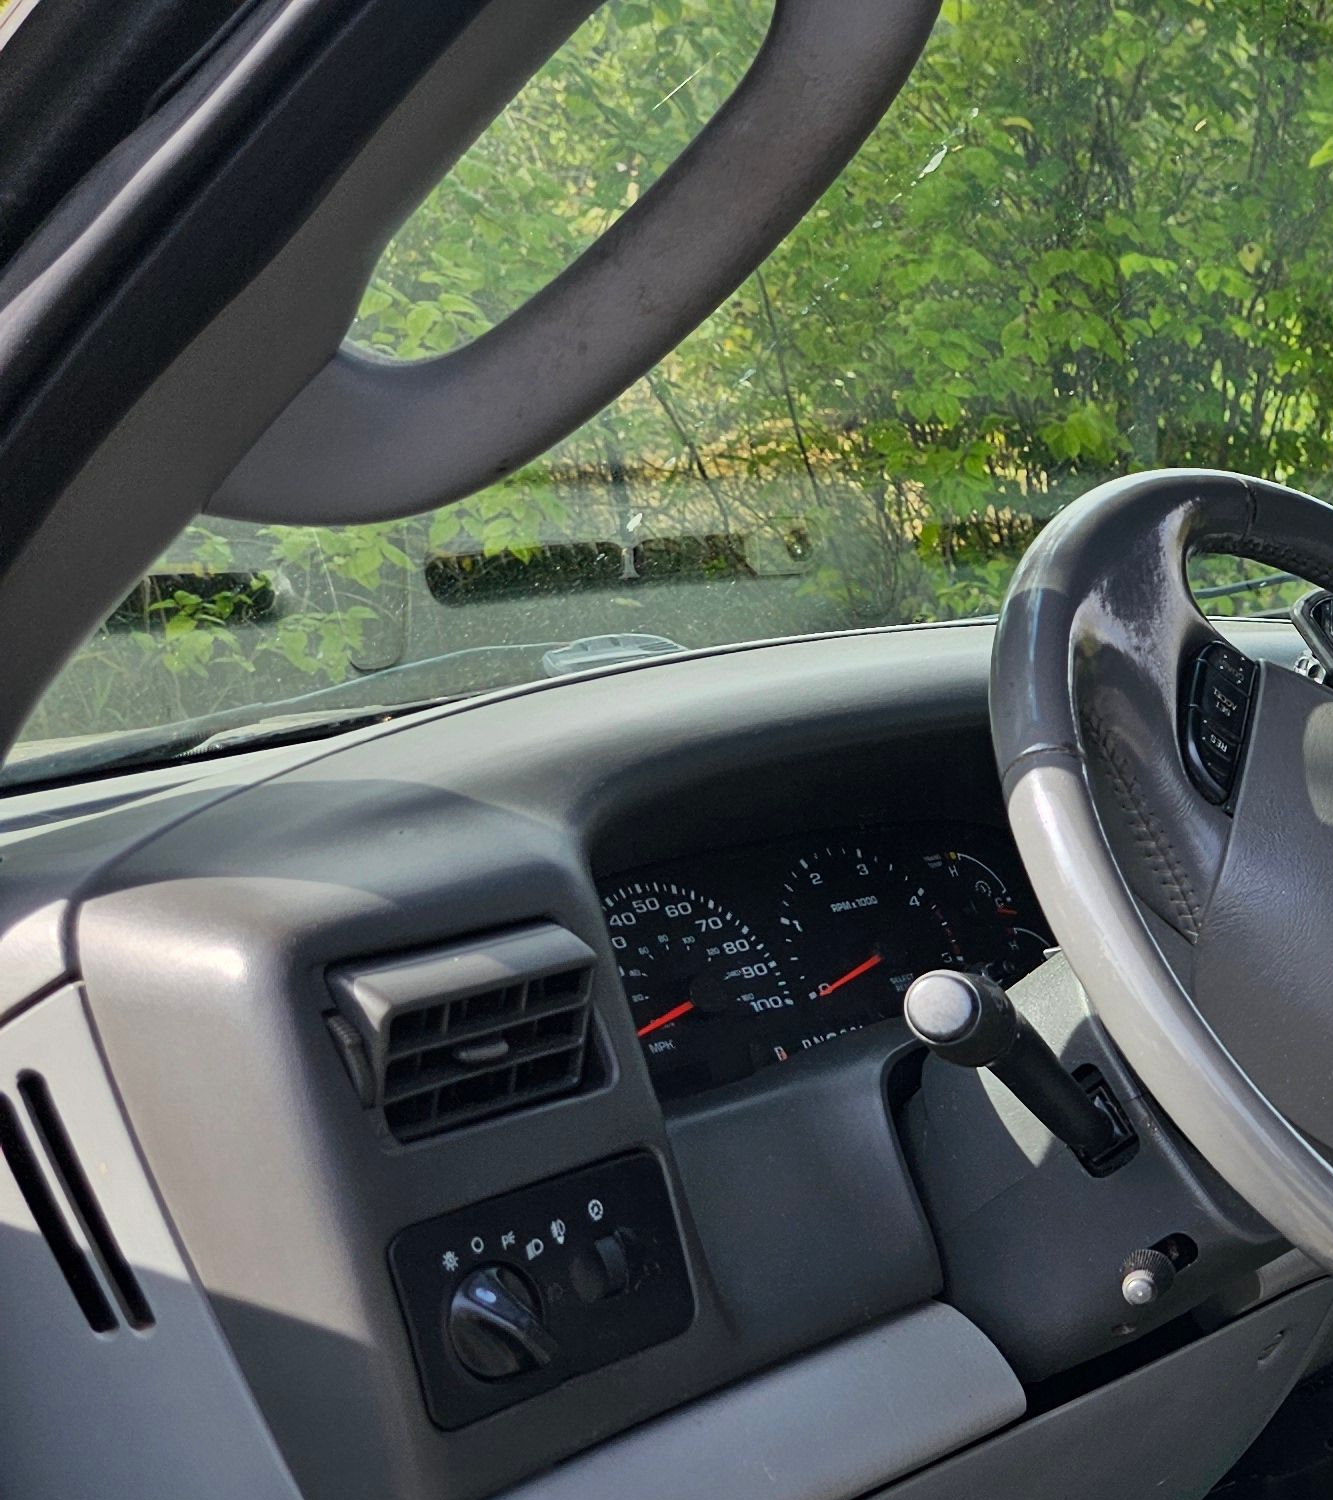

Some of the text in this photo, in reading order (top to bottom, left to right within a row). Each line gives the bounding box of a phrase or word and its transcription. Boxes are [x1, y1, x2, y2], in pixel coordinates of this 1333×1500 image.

[1210, 734, 1228, 753] RES
[856, 863, 869, 876] 3
[948, 864, 959, 878] H
[809, 872, 823, 885] 2
[632, 897, 660, 913] 50
[909, 895, 920, 907] 4
[665, 901, 692, 918] 60
[609, 912, 636, 927] 40
[695, 916, 723, 933] 70
[722, 938, 750, 955] 80
[941, 952, 953, 963] 5
[741, 963, 768, 979] 90
[750, 996, 783, 1012] 100
